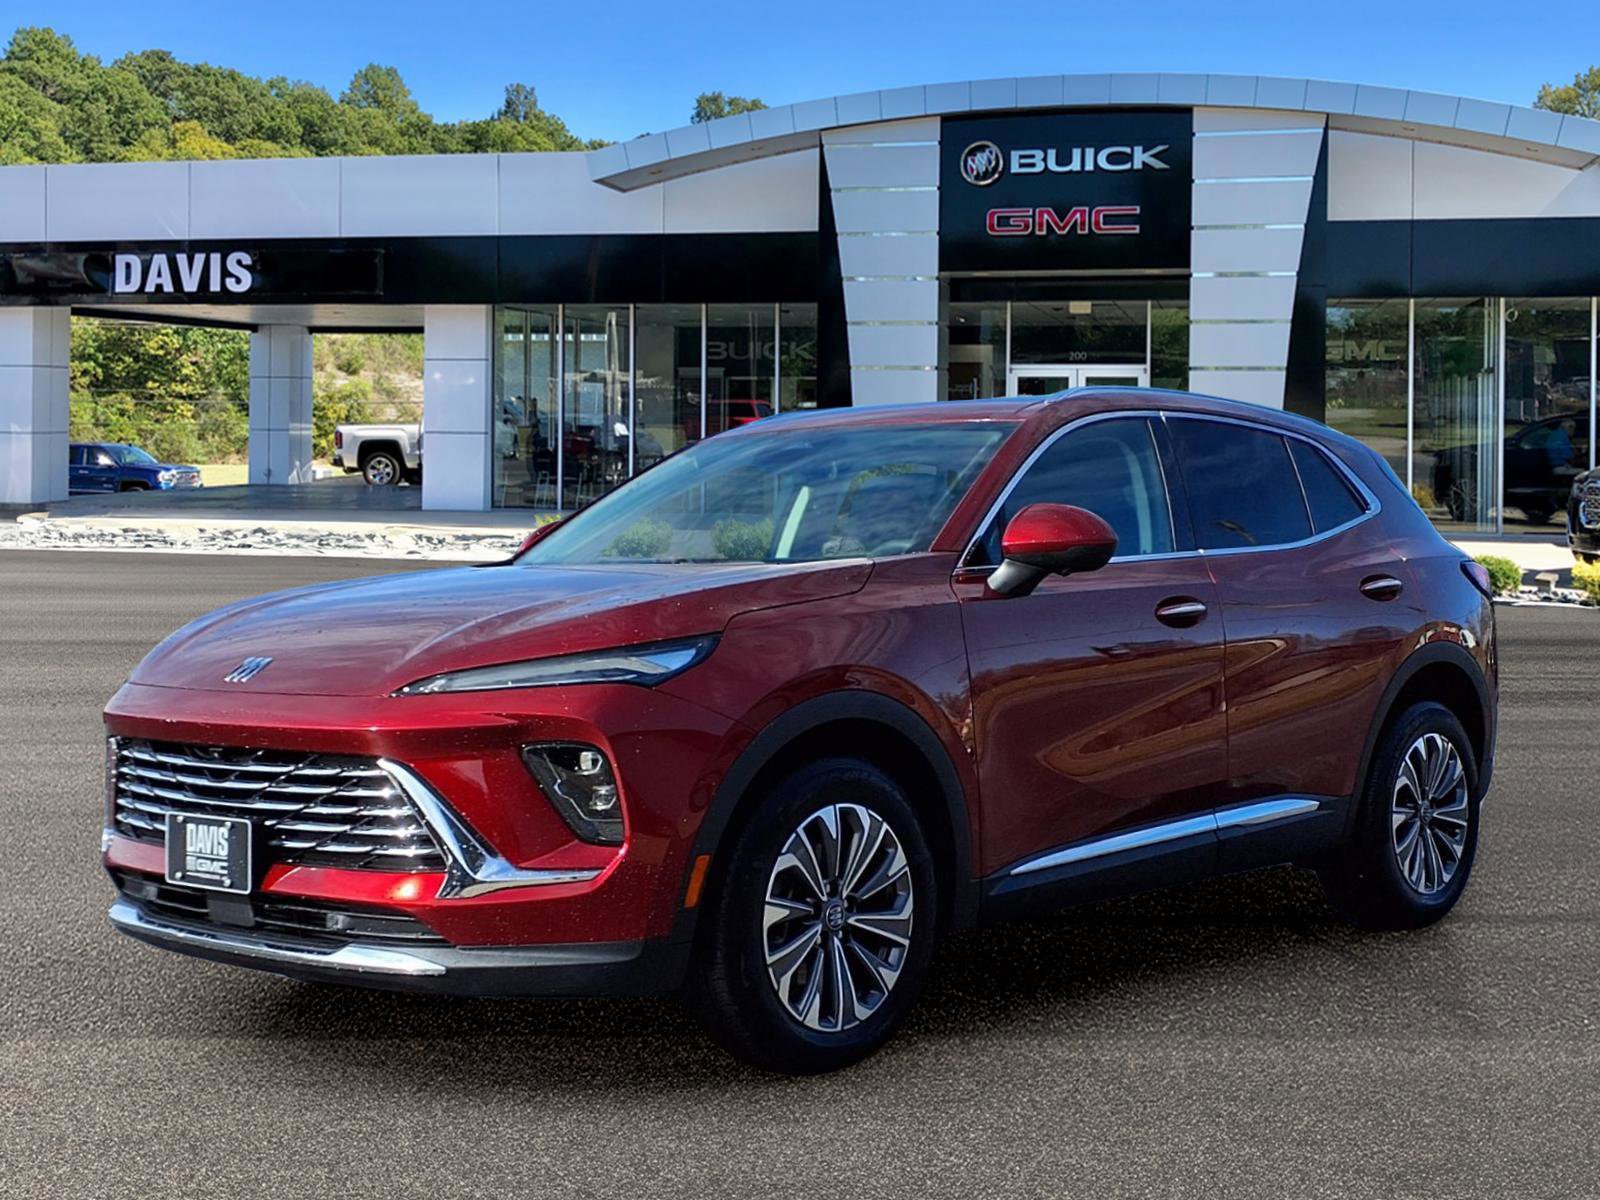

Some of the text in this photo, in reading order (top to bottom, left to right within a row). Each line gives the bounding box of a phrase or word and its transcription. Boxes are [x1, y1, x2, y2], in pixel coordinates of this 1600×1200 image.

[1010, 144, 1170, 173] BUICK
[986, 206, 1140, 235] GMC
[114, 251, 253, 293] DAVIS
[706, 341, 817, 360] BUICK
[1069, 351, 1087, 361] 200
[185, 823, 229, 856] DAVIS
